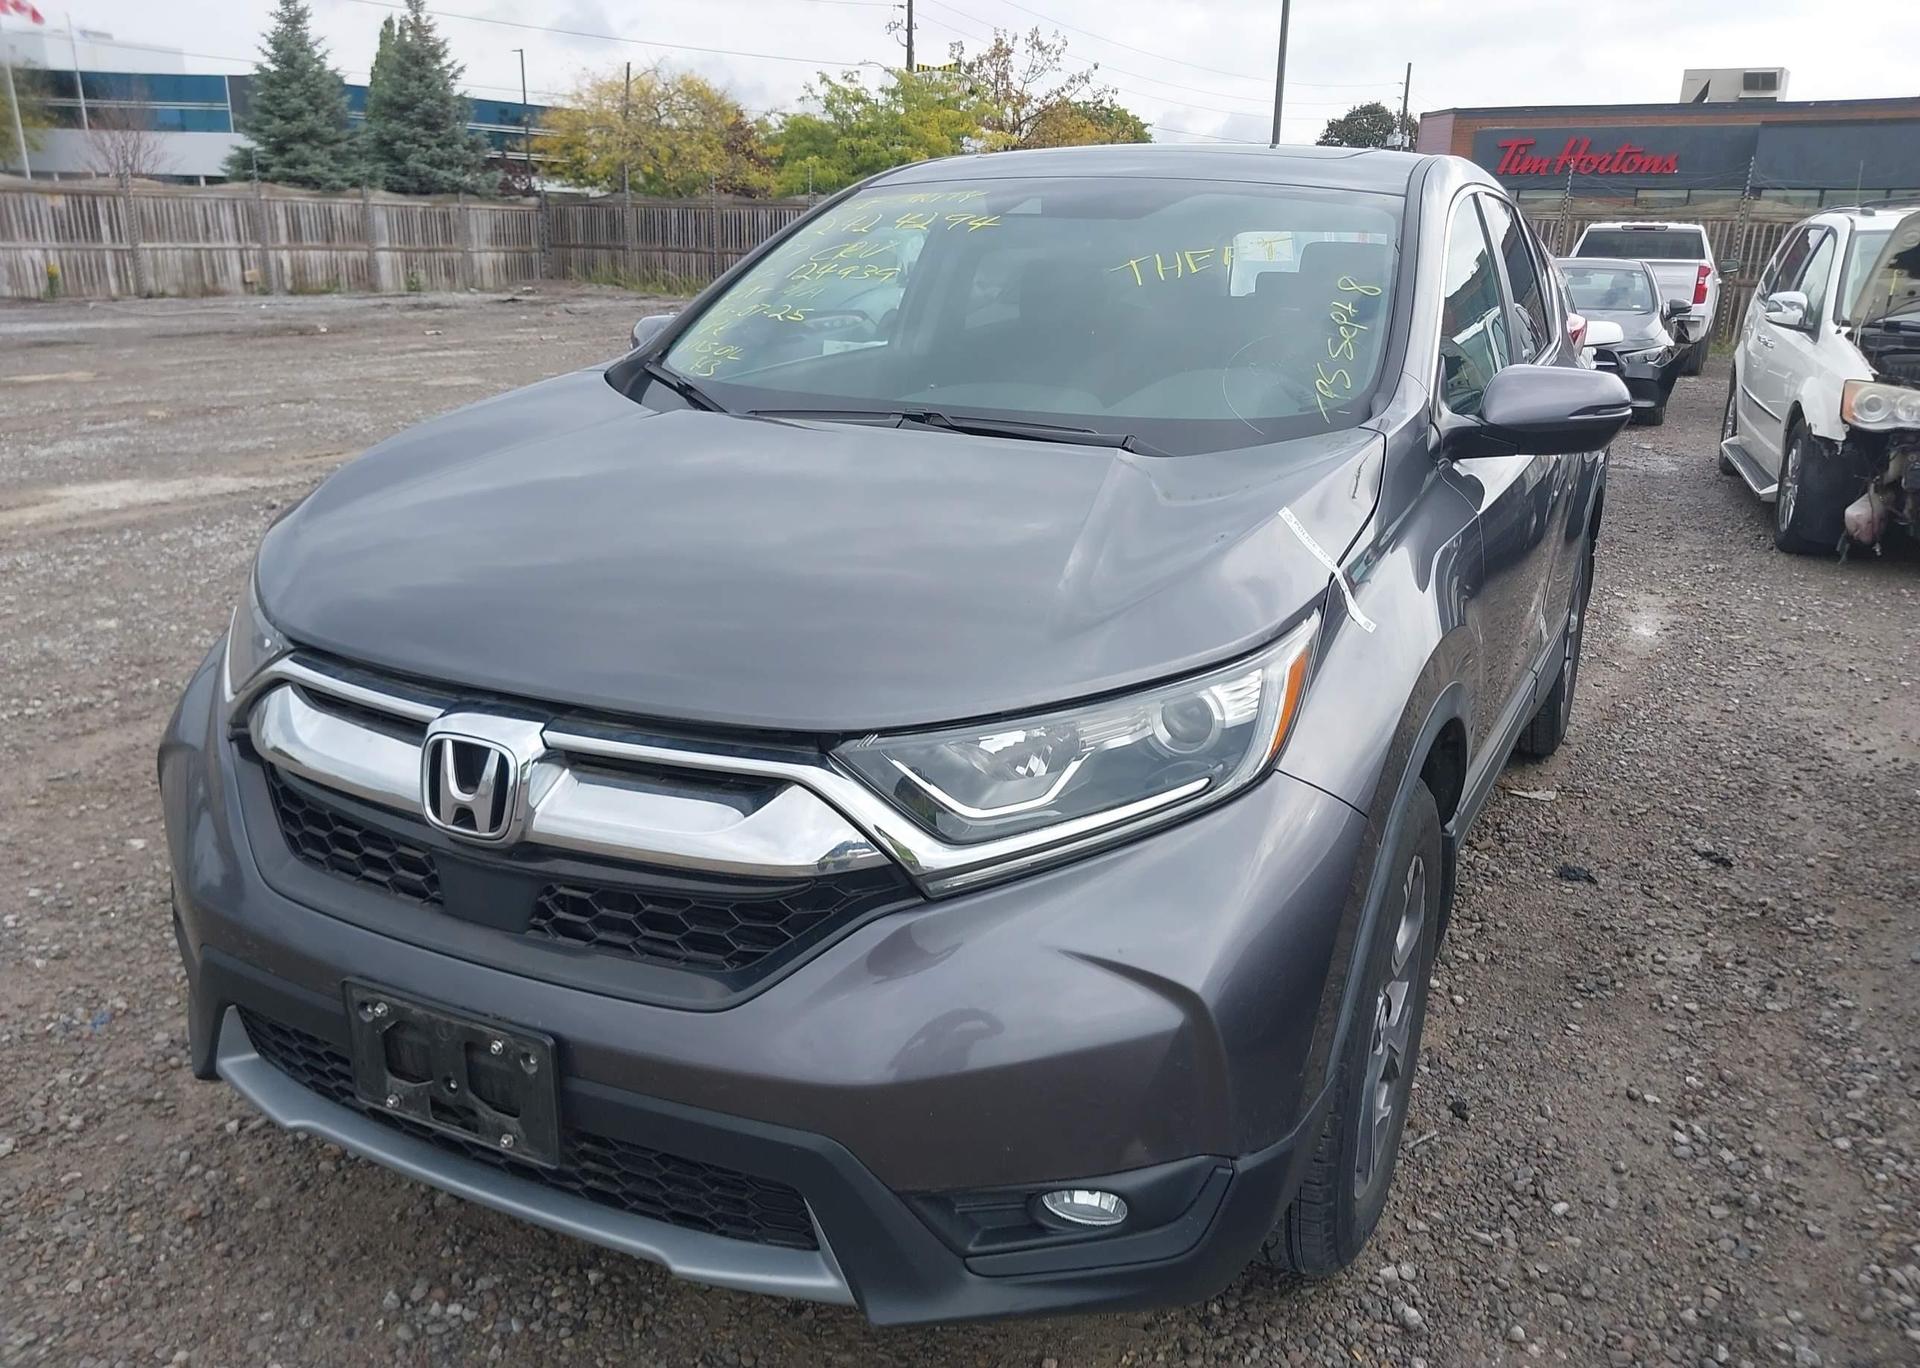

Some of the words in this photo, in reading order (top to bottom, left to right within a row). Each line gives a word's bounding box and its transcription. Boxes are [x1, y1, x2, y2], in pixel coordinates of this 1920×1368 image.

[1497, 137, 1552, 175] Tim
[1553, 137, 1679, 175] Hortons
[1338, 276, 1382, 296] 8
